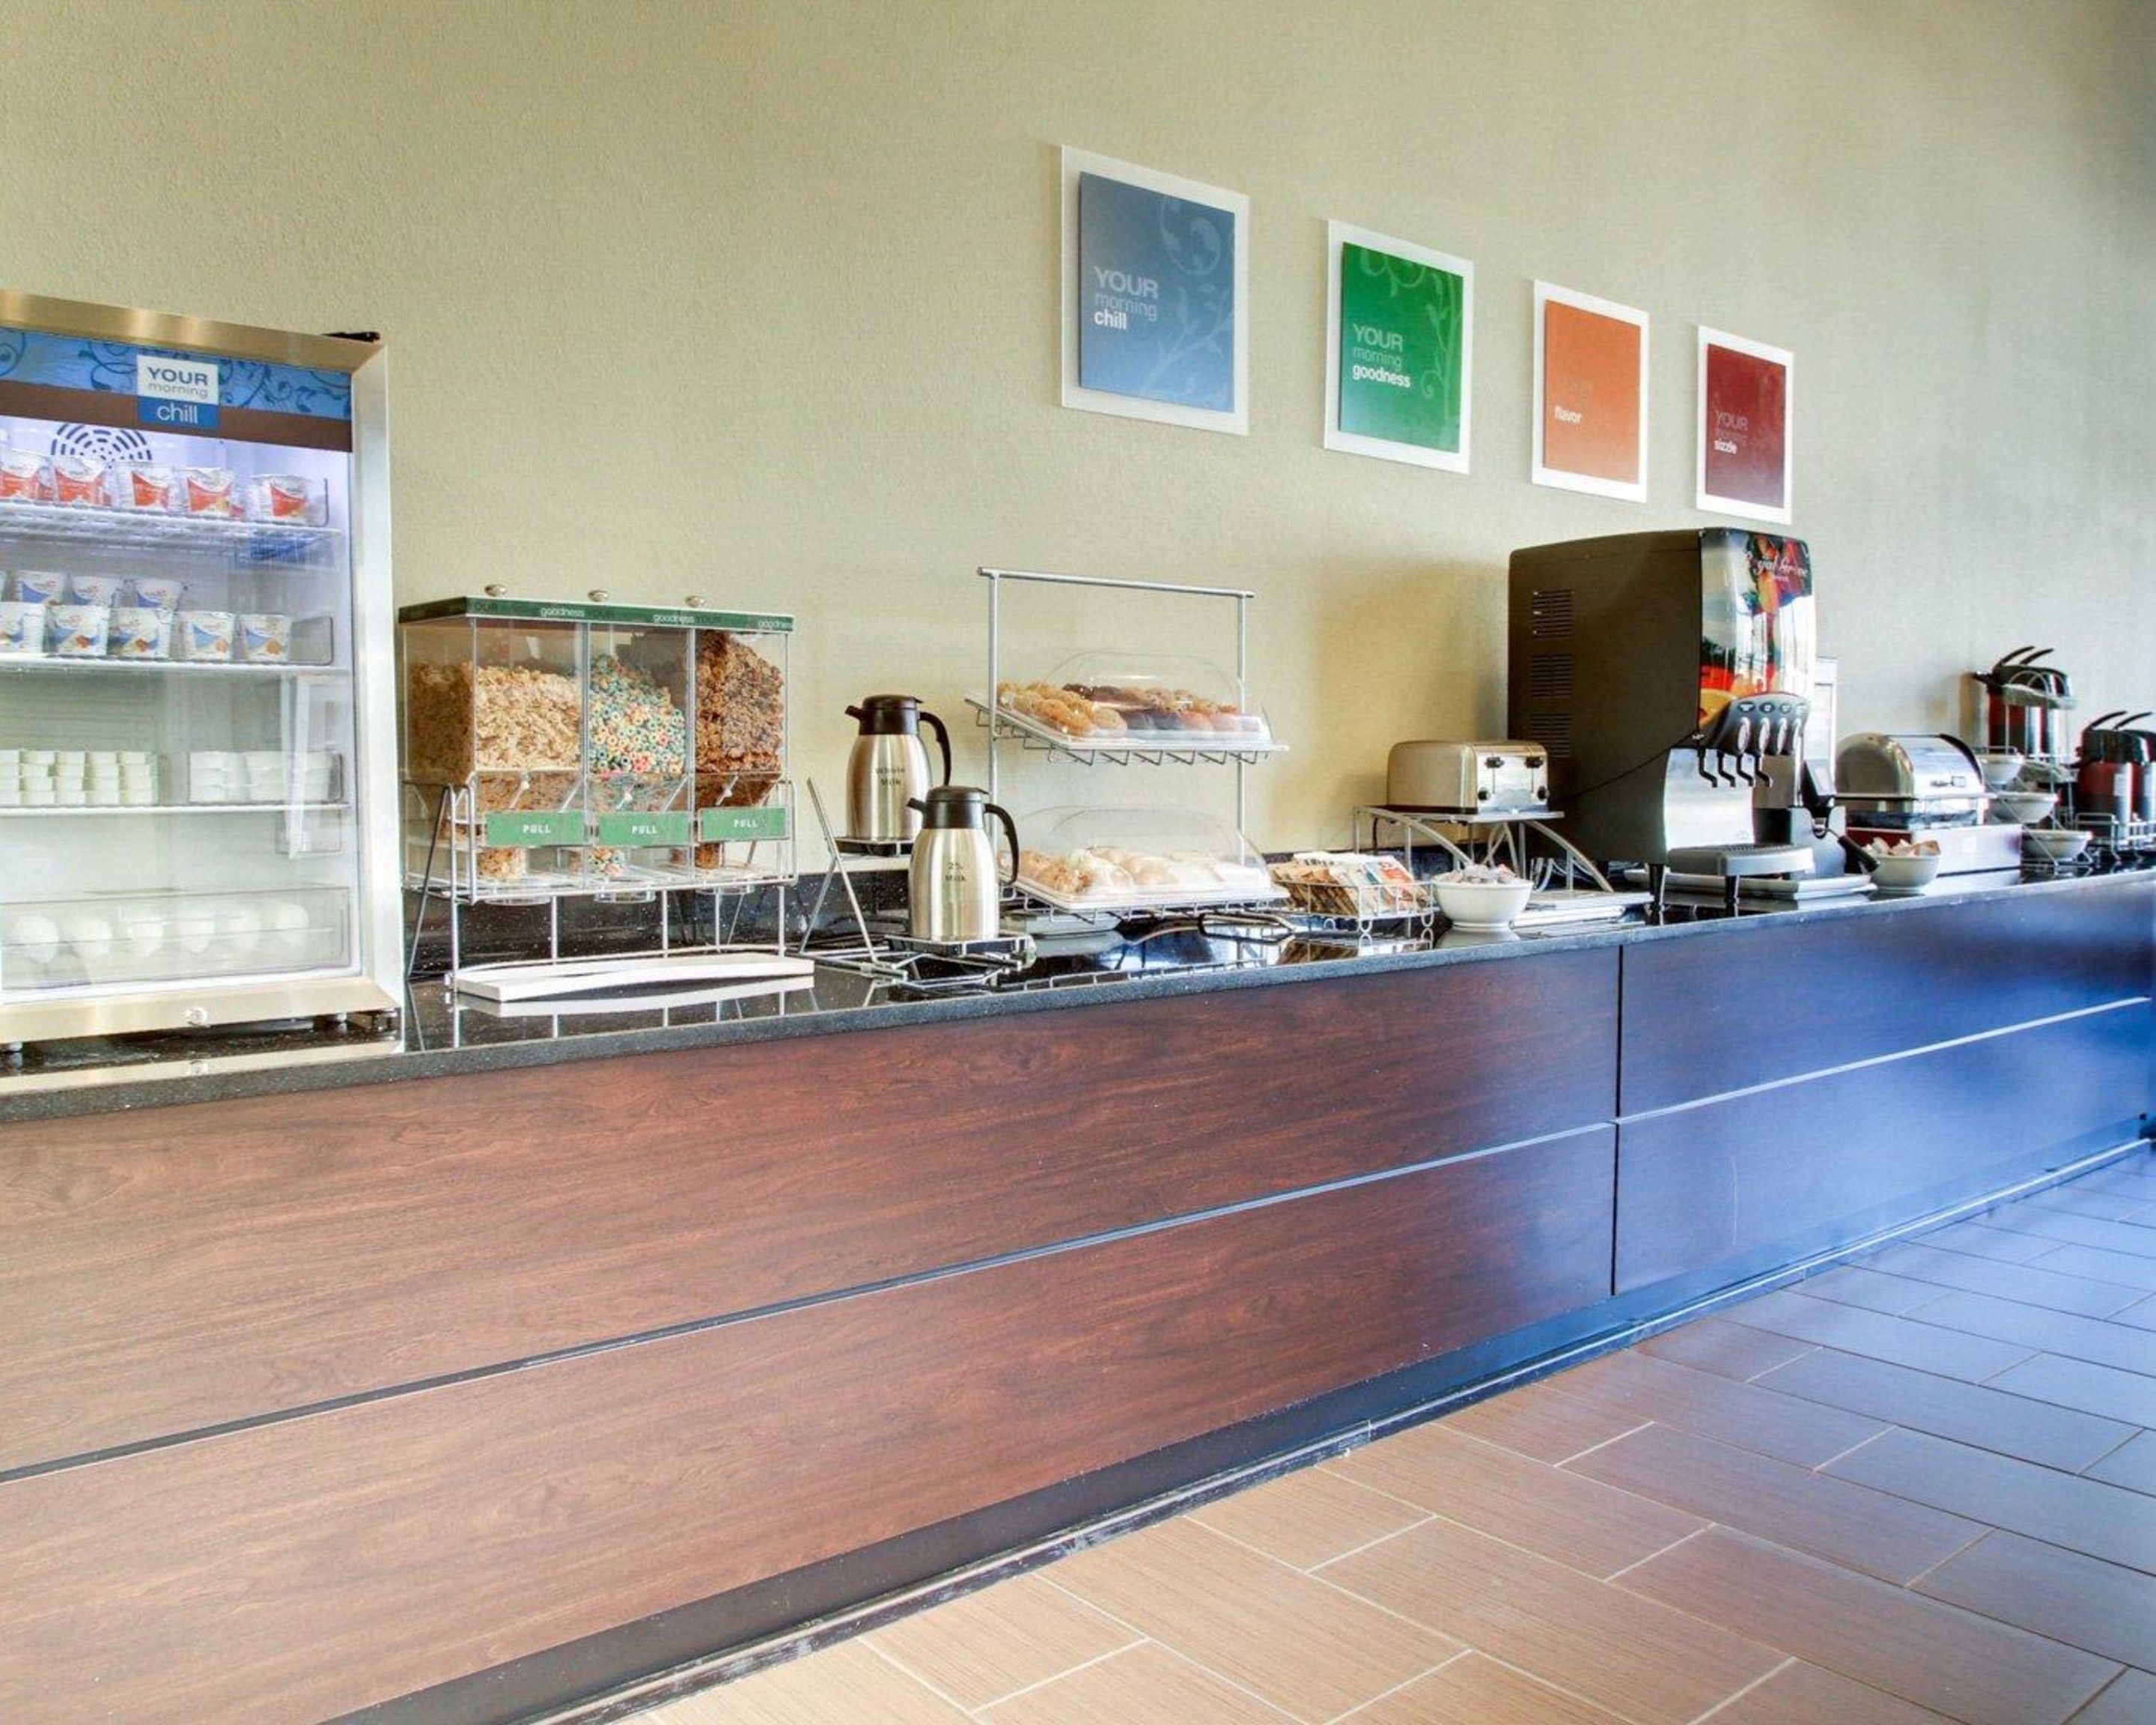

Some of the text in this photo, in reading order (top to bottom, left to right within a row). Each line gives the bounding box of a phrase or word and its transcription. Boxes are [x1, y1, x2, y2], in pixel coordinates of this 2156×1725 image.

[1094, 265, 1159, 299] YOUR
[1094, 293, 1157, 322] morning
[1094, 308, 1127, 330] chill
[1353, 323, 1404, 353] YOUR
[1353, 346, 1402, 372] morning
[147, 366, 208, 386] YOUR
[1352, 365, 1411, 388] goodness
[149, 383, 208, 400] morning
[157, 403, 198, 425] chill
[1555, 405, 1583, 425] flavor
[523, 824, 552, 834] PULL
[632, 824, 658, 836] PULL
[734, 818, 758, 829] PULL
